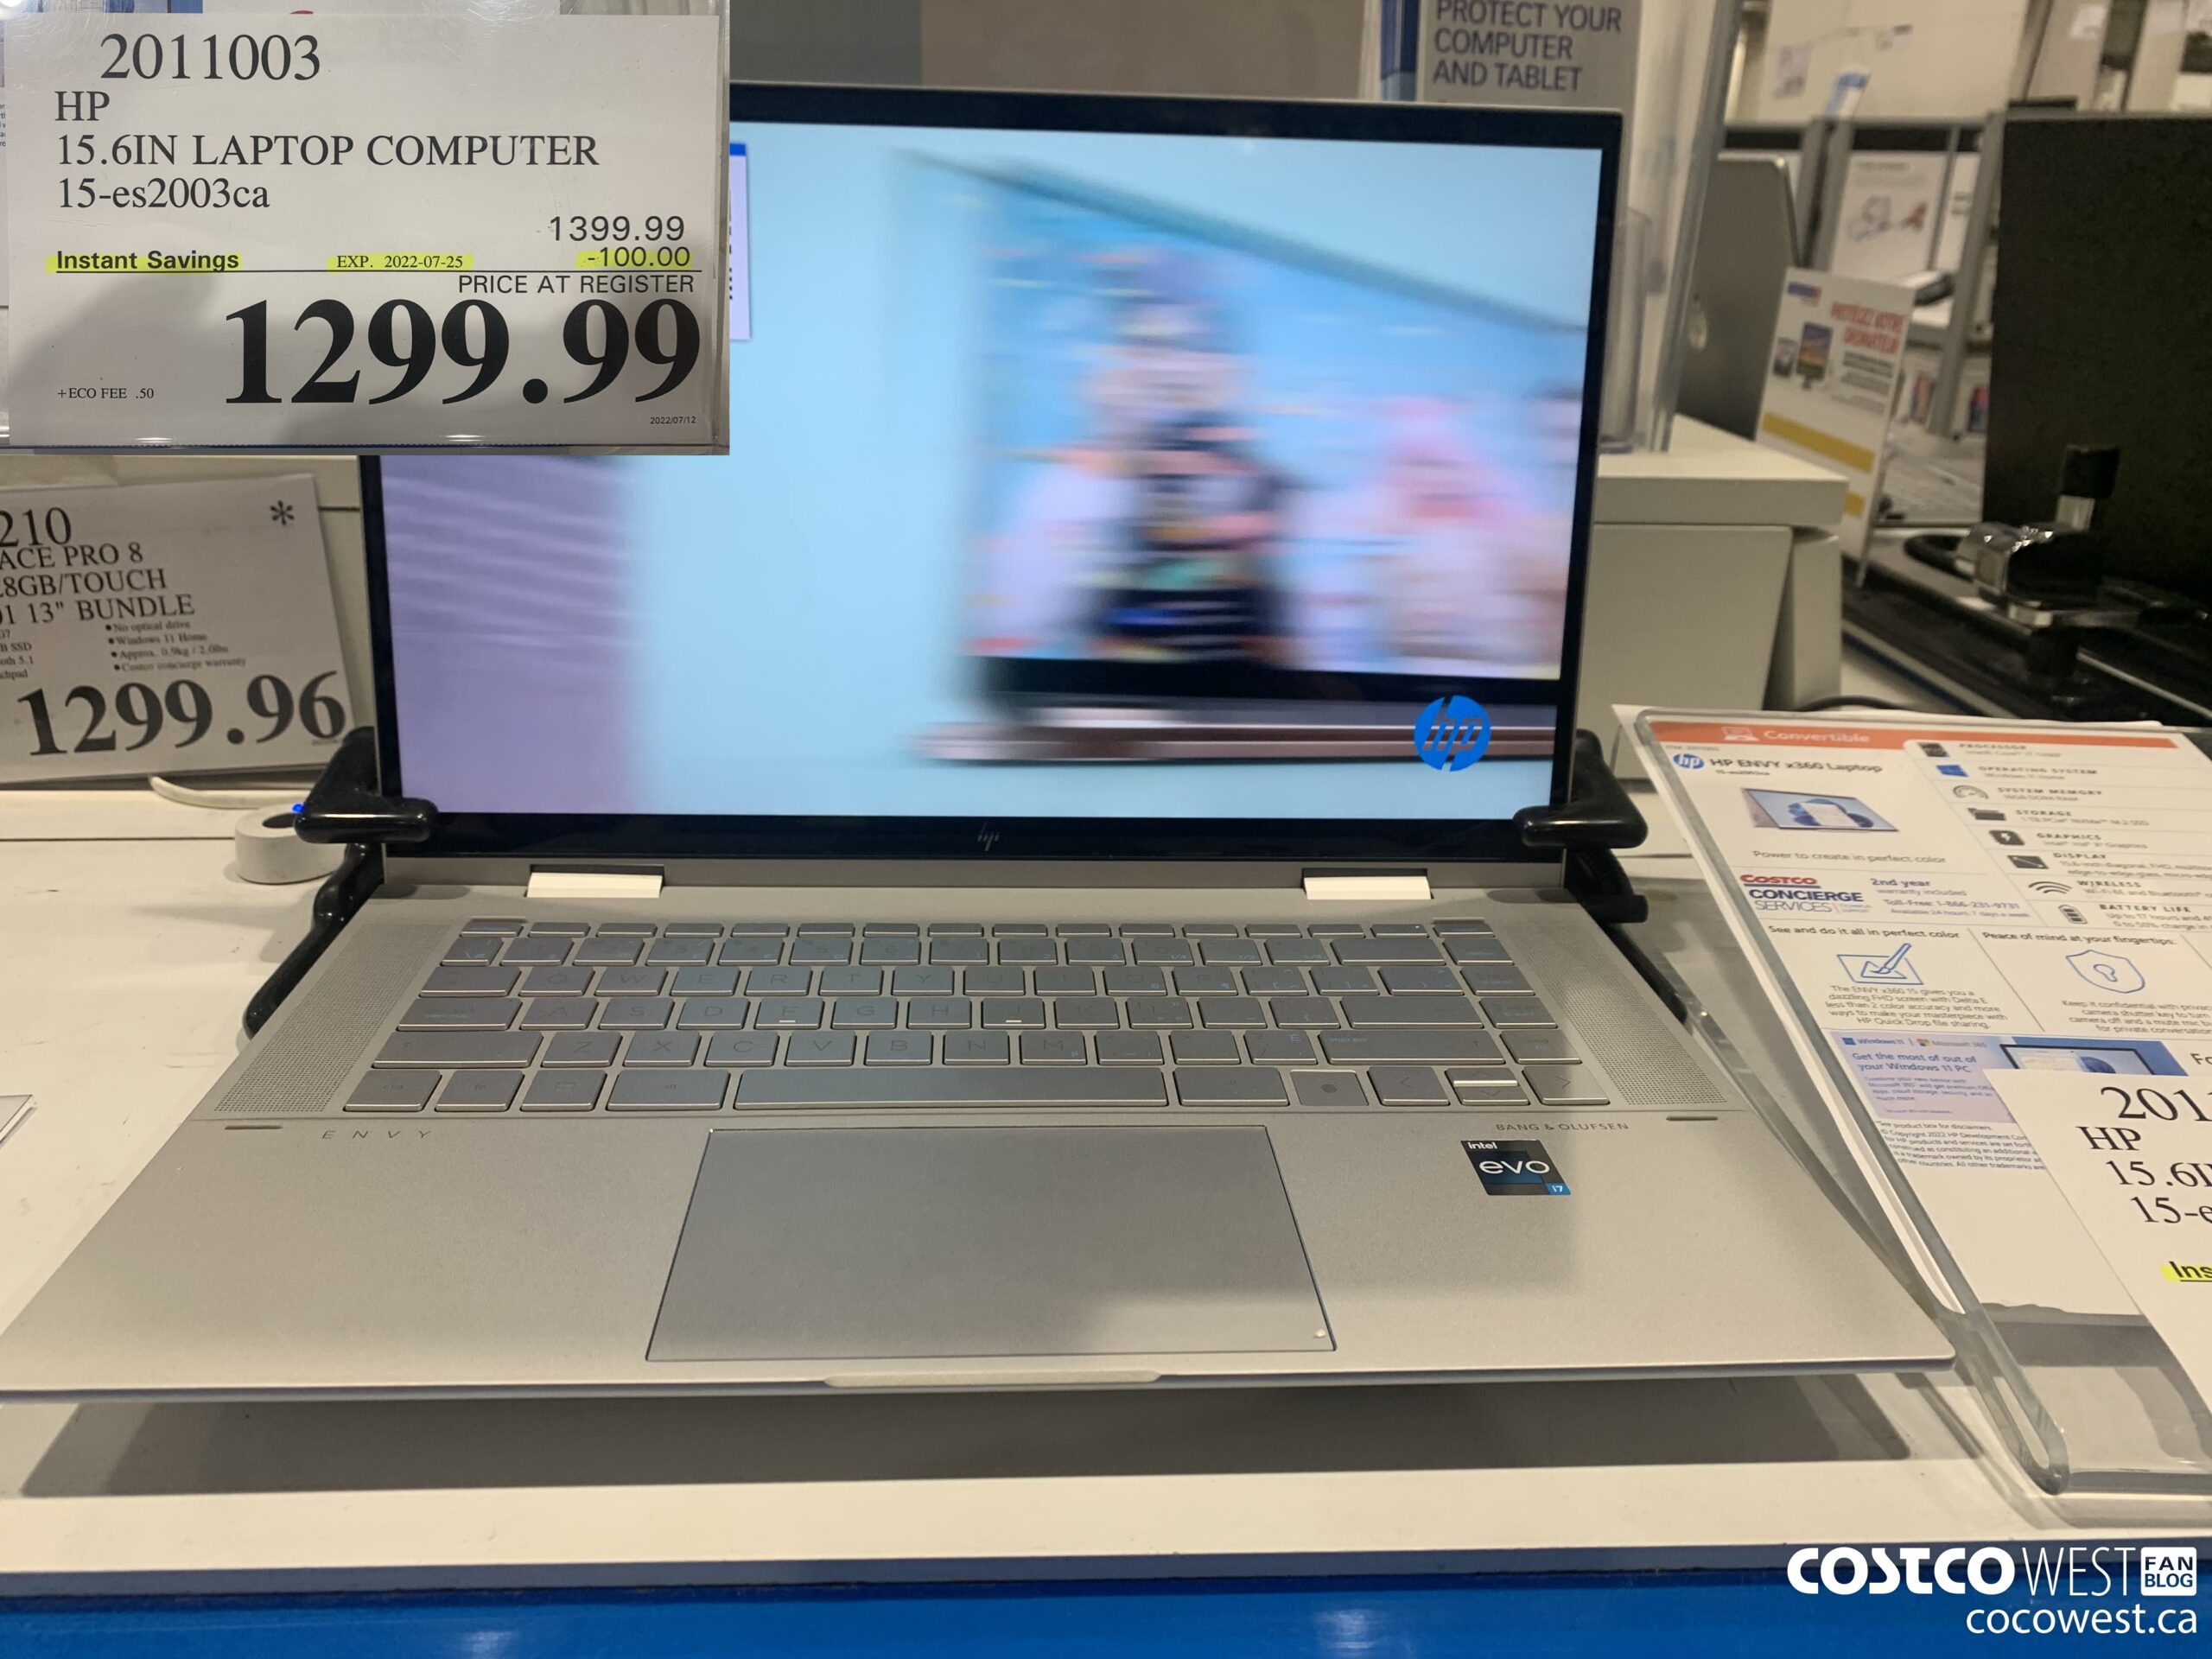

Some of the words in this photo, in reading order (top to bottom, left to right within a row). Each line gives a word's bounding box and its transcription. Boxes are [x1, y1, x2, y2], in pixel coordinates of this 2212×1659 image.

[1436, 0, 1547, 27] PROTECT
[1554, 4, 1622, 32] YOUR
[1434, 28, 1573, 60] COMPUTER
[99, 33, 321, 81] 2011003
[1432, 60, 1488, 86] AND
[1495, 63, 1583, 91] TABLET
[54, 90, 111, 123] HP
[57, 134, 178, 166] 15.6IN
[193, 135, 354, 166] LAPTOP
[366, 135, 598, 166] COMPUTER
[57, 177, 270, 210] 15-es2003ca
[548, 216, 685, 241] 1399.99
[56, 251, 138, 270] Instant
[147, 251, 239, 273] Savings
[337, 255, 374, 269] EXP.
[384, 255, 463, 269] 2022-07-25
[585, 247, 690, 267] -100.00
[458, 274, 527, 294] PRICE
[537, 274, 570, 294] AT
[578, 274, 694, 294] REGISTER
[226, 298, 700, 405] 1299.99
[100, 387, 127, 398] FEE
[135, 387, 154, 398] .50
[650, 415, 696, 424] 2022/07/12
[65, 543, 119, 567] PRO
[128, 542, 143, 563] 8
[0, 569, 166, 598] 8GB/TOUCH
[28, 601, 64, 624] 13"
[76, 594, 195, 621] BUNDLE
[166, 620, 191, 630] drive
[11, 641, 32, 652] SSD
[17, 671, 346, 757] 1299.96
[1417, 696, 1488, 771] hp
[1764, 730, 1870, 743] Convertible
[1678, 754, 1700, 768] hp
[1710, 759, 1732, 767] HP
[1738, 760, 1780, 769] ENVY
[1785, 761, 1823, 770] x360
[1827, 762, 1882, 773] Laptop
[1752, 850, 1791, 859] Power
[1868, 855, 1913, 863] perfect
[1740, 874, 1818, 885] COSTCO
[1870, 878, 1898, 887] 2nd
[1900, 880, 1930, 888] year
[1749, 889, 1865, 902] CONCIERGE
[1755, 900, 1833, 912] SERVICES
[1768, 925, 1791, 934] See
[1883, 929, 1927, 938] perfect
[1929, 930, 1960, 938] color
[1982, 931, 2018, 940] Peace
[1828, 994, 1870, 1002] dazzling
[1828, 1009, 1855, 1018] ways
[1923, 1012, 1985, 1020] masterpiece
[1907, 1004, 1951, 1013] accuracy
[1874, 1018, 1904, 1027] Quick
[1904, 1019, 1932, 1027] Drop
[1853, 1052, 1872, 1061] Get
[1876, 1052, 1895, 1061] the
[1942, 1055, 1962, 1064] out
[1965, 1055, 1978, 1064] of
[1858, 1064, 1884, 1072] your
[1886, 1063, 1940, 1072] Windows
[322, 1130, 431, 1140] ENVY
[2075, 1126, 2142, 1151] HP
[1467, 1141, 1498, 1150] intel
[1478, 1160, 1550, 1174] evo
